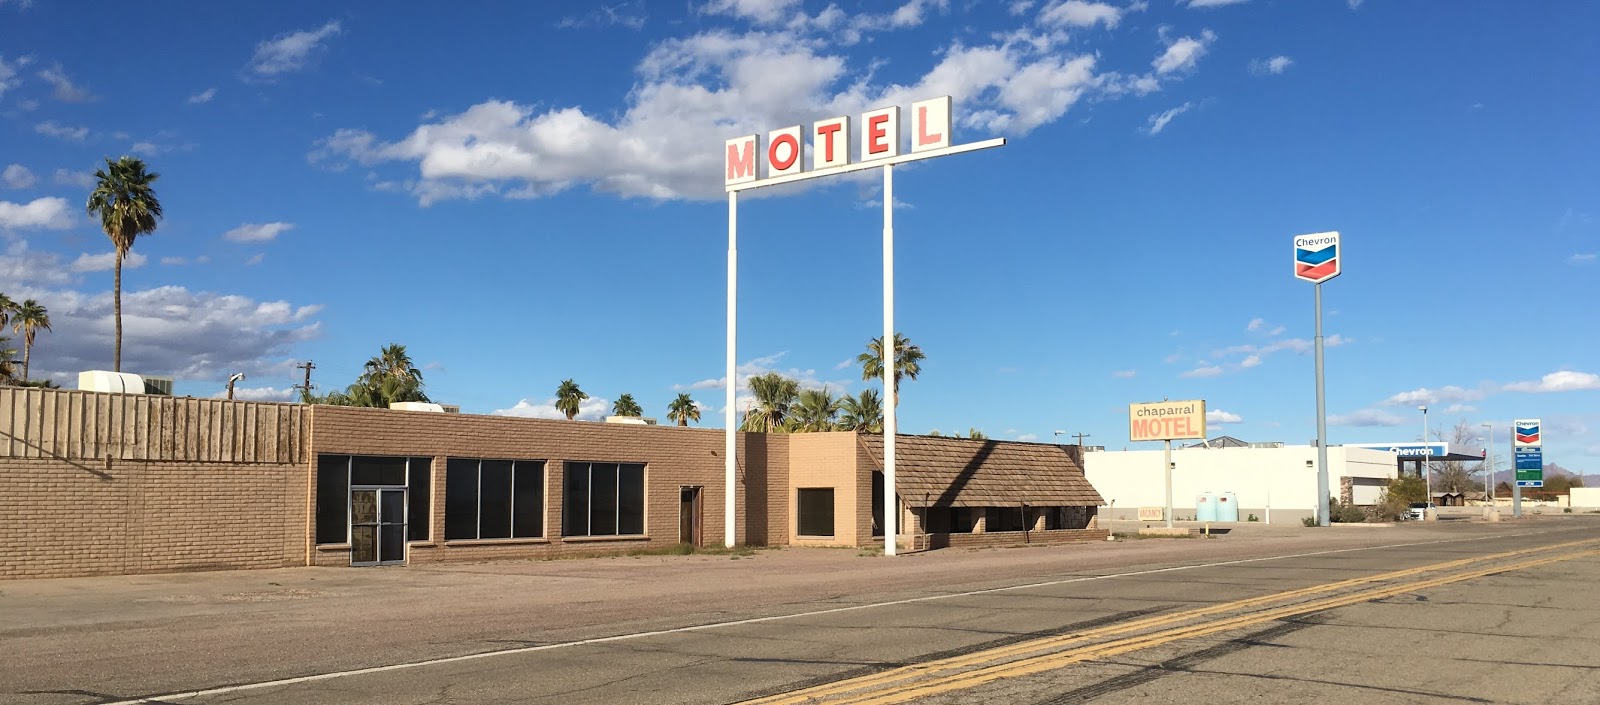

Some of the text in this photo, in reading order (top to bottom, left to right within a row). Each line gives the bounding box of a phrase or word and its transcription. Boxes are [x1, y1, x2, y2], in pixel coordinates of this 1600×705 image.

[727, 106, 941, 180] MOTEL
[1296, 236, 1337, 247] Chevron
[1137, 404, 1194, 417] chaparral
[1133, 417, 1198, 438] MOTEL
